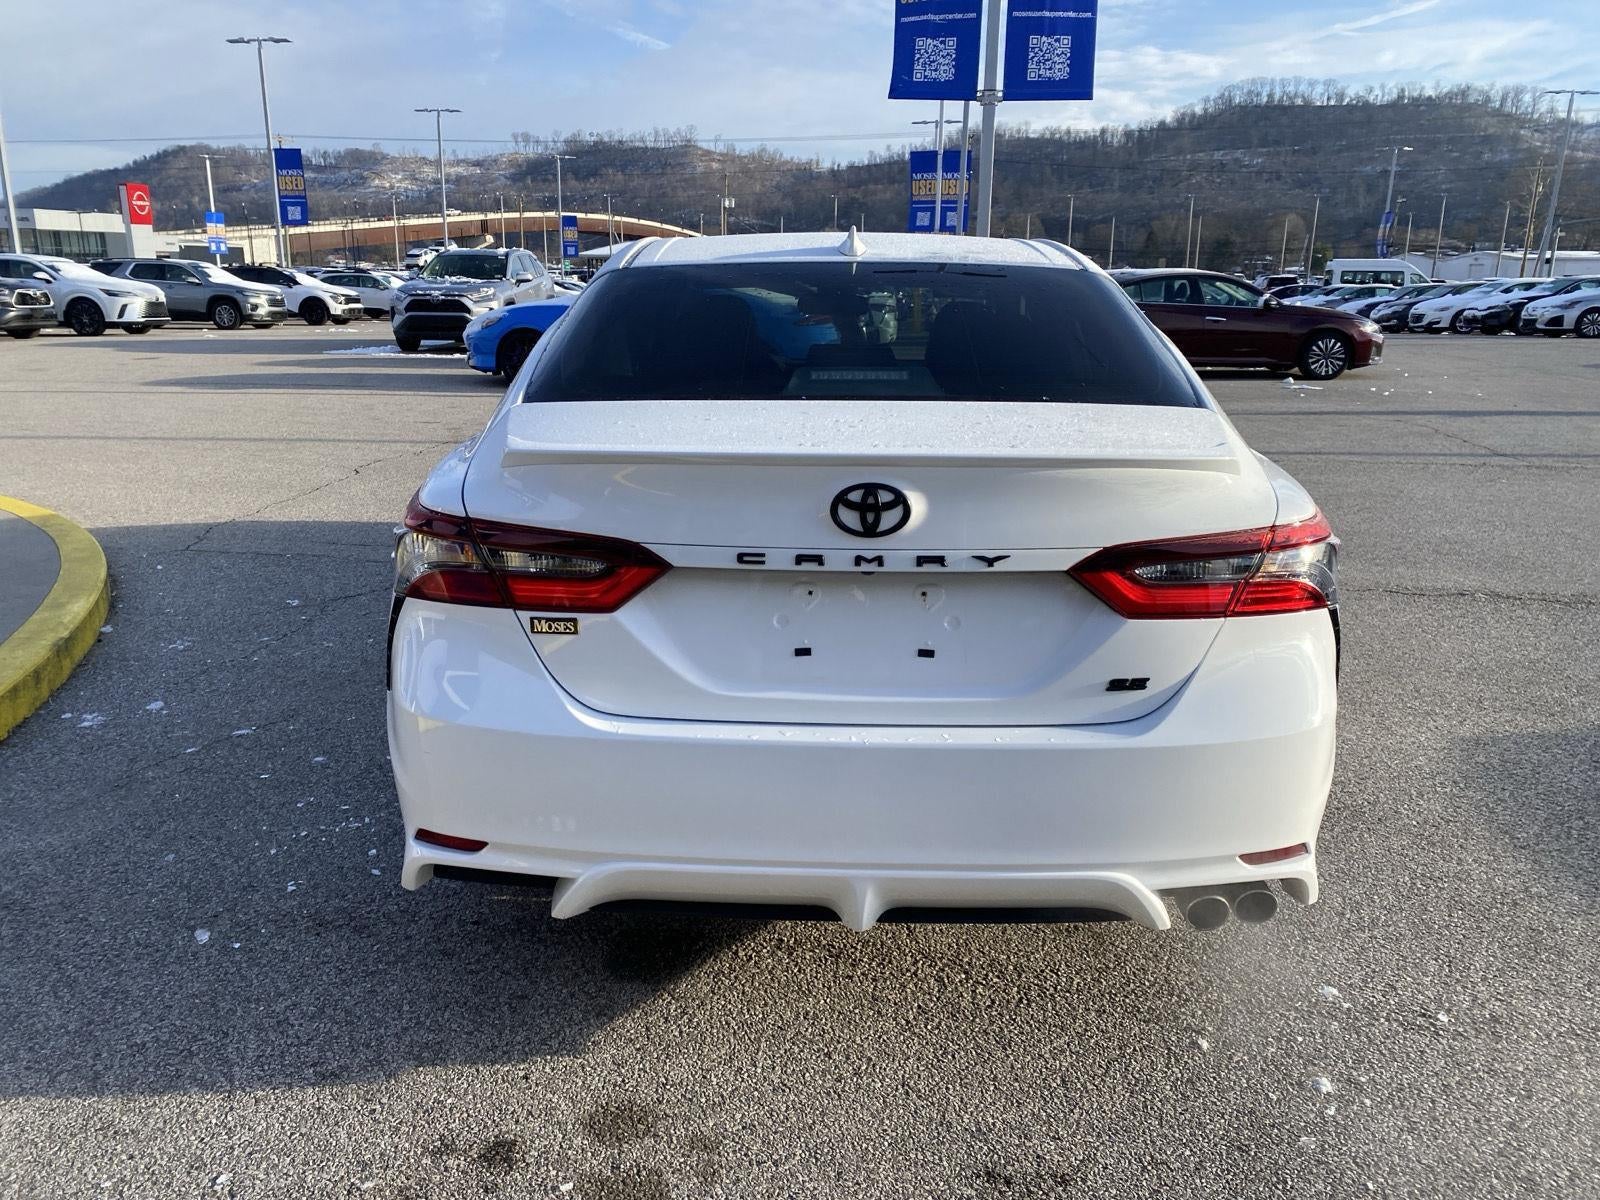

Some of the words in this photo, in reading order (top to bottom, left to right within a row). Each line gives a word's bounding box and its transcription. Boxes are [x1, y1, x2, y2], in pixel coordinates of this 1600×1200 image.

[279, 176, 304, 190] USED
[737, 552, 1011, 568] CAMRY
[533, 619, 575, 633] MOSES
[1105, 677, 1151, 691] SE
